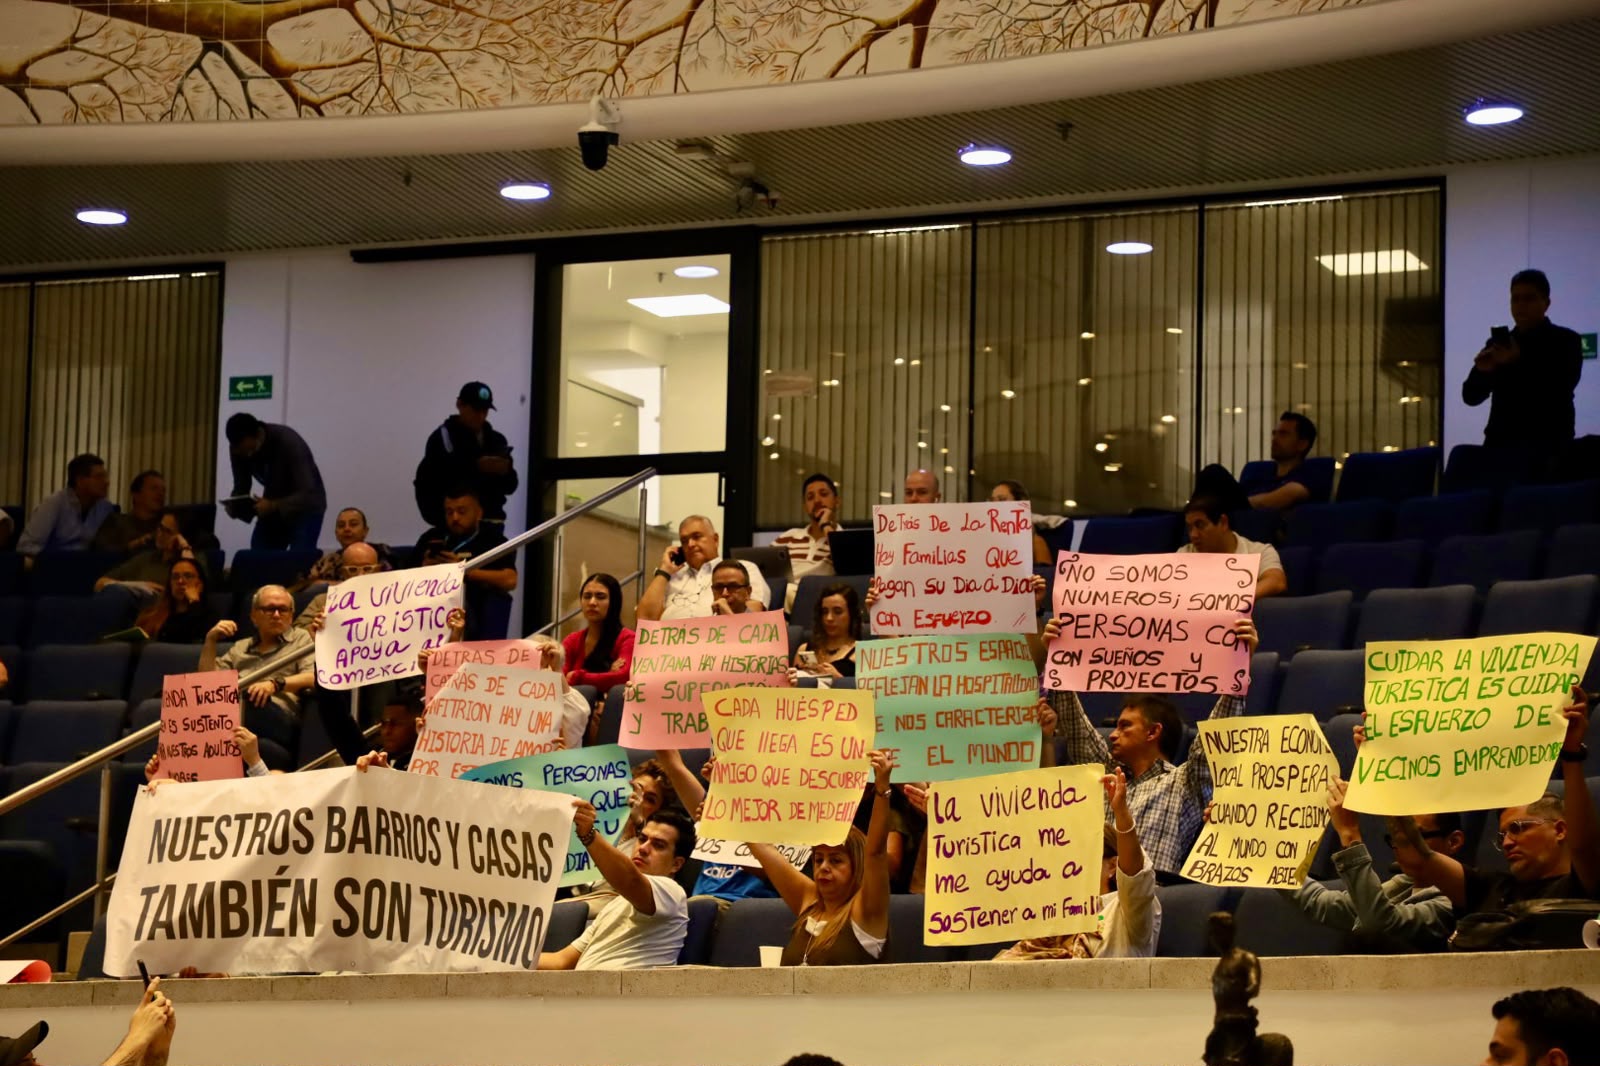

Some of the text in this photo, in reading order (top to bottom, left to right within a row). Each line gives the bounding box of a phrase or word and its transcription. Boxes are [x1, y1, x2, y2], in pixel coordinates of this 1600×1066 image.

[928, 514, 951, 532] De
[1066, 563, 1188, 583] NO SOMOS
[1187, 593, 1253, 614] SOMOS
[706, 625, 728, 644] DE
[738, 623, 780, 644] CADA
[1059, 612, 1189, 642] PERSONAS
[507, 648, 530, 665] DE
[632, 654, 788, 676] VENTANA HAY HISTORIAS
[860, 642, 968, 673] NUESTROS
[1051, 649, 1083, 667] CON
[1089, 647, 1164, 667] SUEÑOS
[1368, 643, 1579, 675] CUIDAR LA VIVIENDA
[484, 676, 507, 696] DE
[518, 681, 556, 700] CADA
[933, 675, 953, 697] LA
[1368, 676, 1470, 705] TURISTICA
[1477, 677, 1506, 700] ES
[499, 705, 521, 727] HAY
[528, 710, 553, 735] UNA
[715, 696, 858, 721] CADA HUÉSPED
[183, 715, 233, 733] SUSTENTO
[661, 712, 709, 735] TRAB
[895, 714, 926, 732] NOS
[1389, 708, 1491, 738] ESFUERZO
[1514, 705, 1552, 729] DE
[416, 729, 484, 755] HISTORIA
[489, 737, 509, 756] DE
[717, 727, 745, 753] QUE
[810, 733, 834, 757] ES
[841, 737, 865, 760] UN
[1205, 727, 1270, 754] NUESTRA
[928, 745, 954, 766] EL
[968, 741, 1034, 765] MUNDO
[543, 761, 627, 786] PERSONAS
[762, 765, 790, 788] QUE
[1213, 762, 1329, 793] LOCAL PROSPERA
[1358, 754, 1441, 784] VECINOS
[590, 787, 628, 812] QUE
[706, 796, 727, 820] LO
[731, 797, 781, 822] MEJOR
[790, 802, 805, 820] DE
[1210, 803, 1257, 827] CUANDO
[147, 805, 554, 883] NUESTROS BARRIOS Y CASAS
[1038, 827, 1070, 847] me
[1197, 832, 1218, 857] AL
[1228, 837, 1266, 859] MUNDO
[1276, 841, 1298, 859] CON
[935, 857, 1083, 894] me ayuda a
[1187, 860, 1253, 883] BRAZOS
[134, 865, 544, 971] TAMBIÉN SON TURISMO
[1022, 907, 1036, 921] a
[1042, 902, 1057, 920] mi
